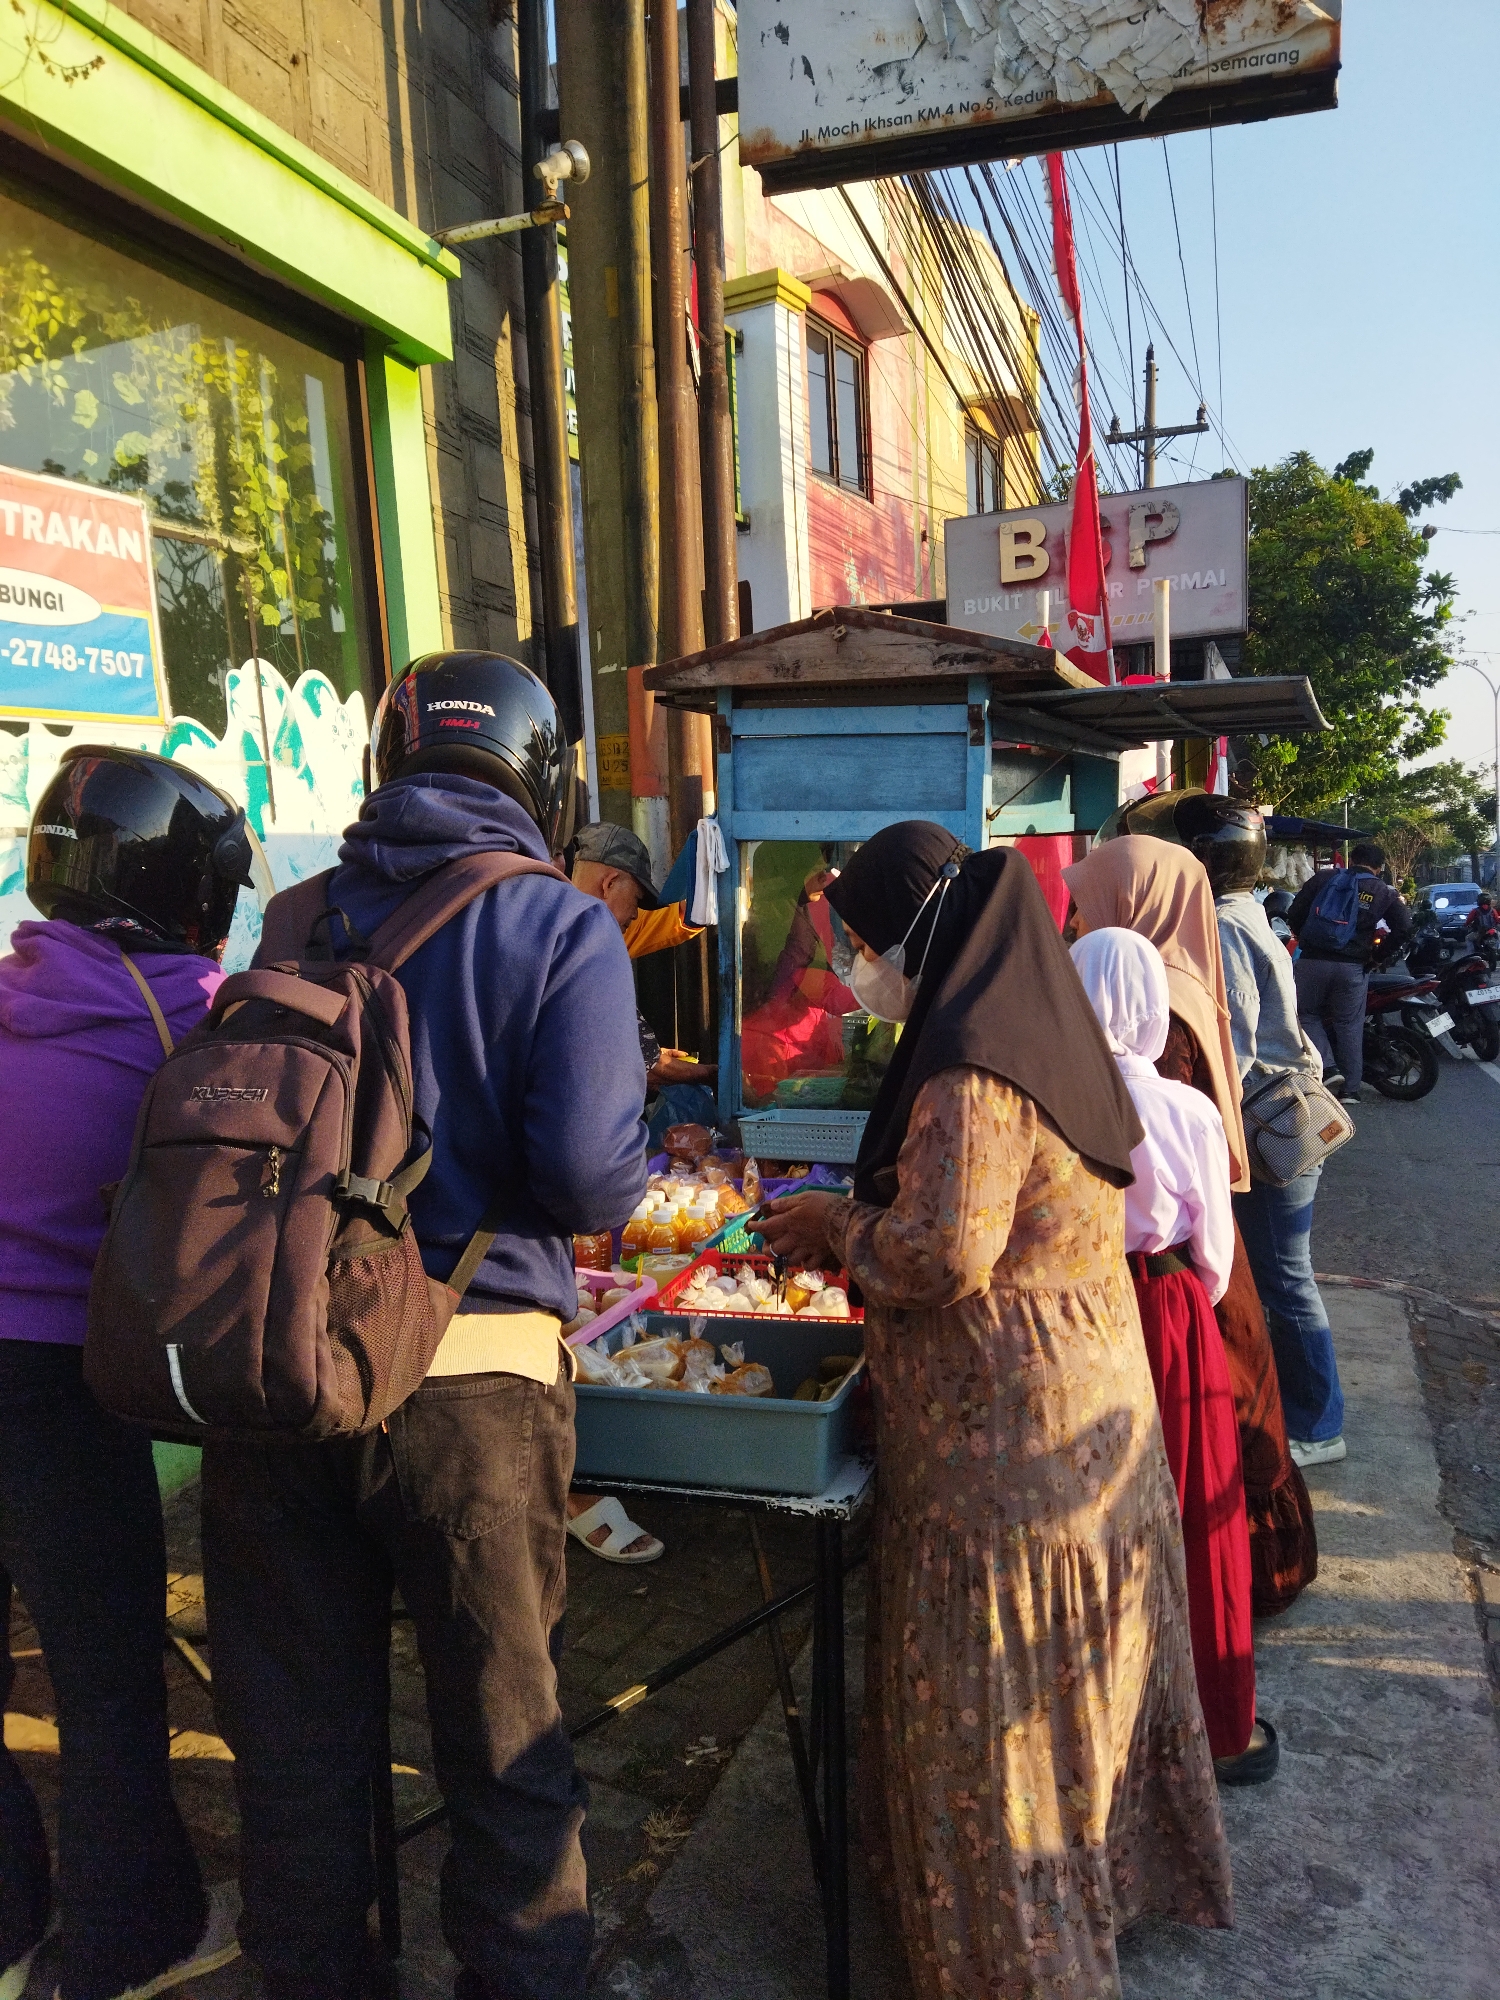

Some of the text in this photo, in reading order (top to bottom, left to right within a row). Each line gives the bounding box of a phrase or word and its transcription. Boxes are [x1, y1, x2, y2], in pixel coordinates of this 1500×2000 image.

[799, 129, 813, 143] Jl.
[818, 121, 859, 141] Moch
[864, 114, 912, 132] Ikhsan
[917, 103, 954, 122] KM.4
[1004, 89, 1058, 107] Kedun
[0, 501, 143, 563] TRAKAN
[0, 584, 64, 612] BUNGI
[963, 593, 1023, 615] BUKIT
[427, 700, 496, 717] HONDA
[33, 824, 78, 840] HONDA
